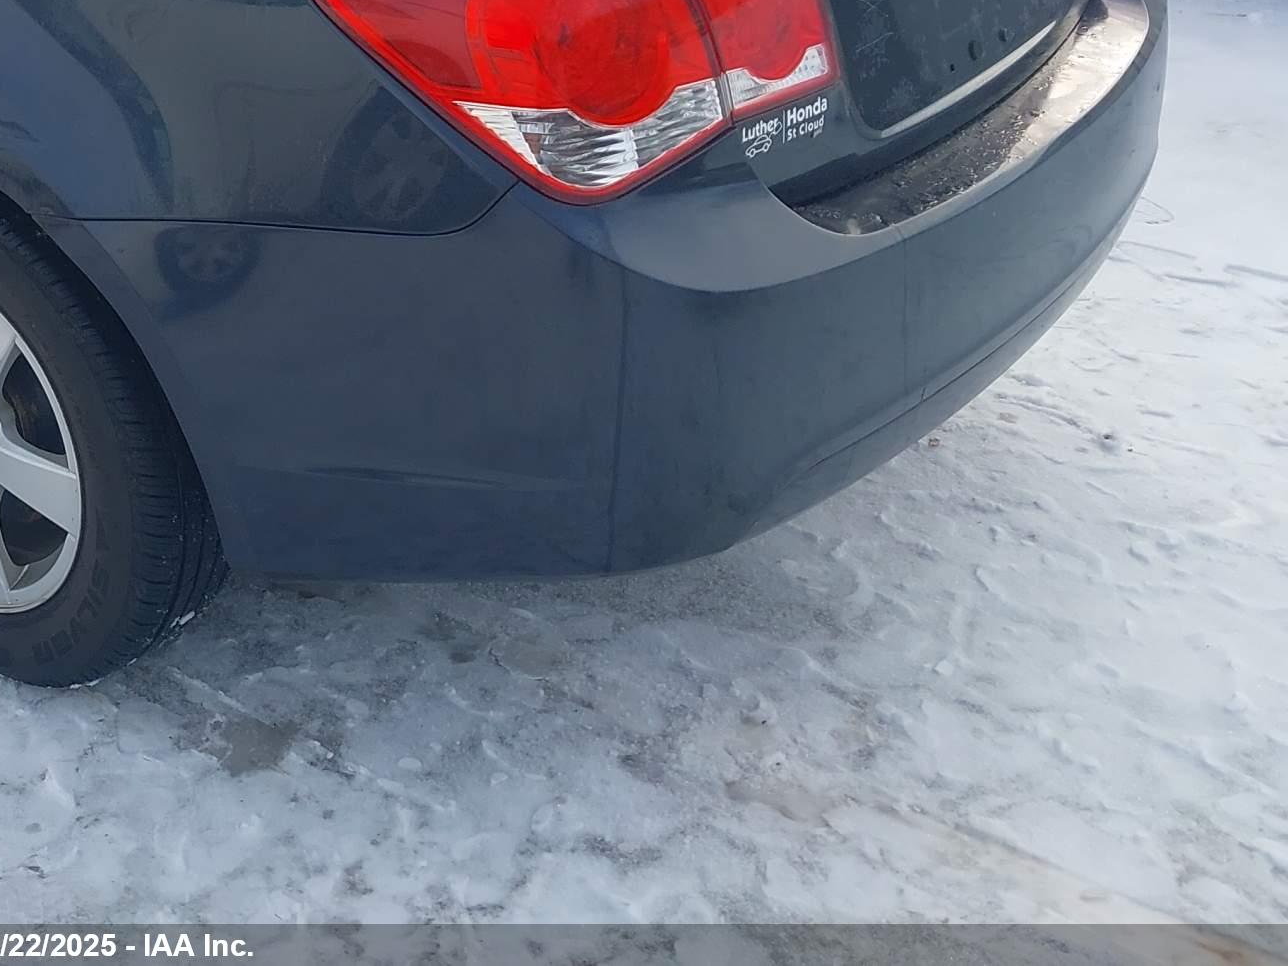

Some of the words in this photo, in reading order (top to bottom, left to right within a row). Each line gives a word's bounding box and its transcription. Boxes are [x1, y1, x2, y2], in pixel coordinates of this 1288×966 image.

[786, 96, 828, 127] Honda
[742, 116, 779, 143] Luther
[787, 127, 797, 142] St
[799, 114, 825, 136] Cloud
